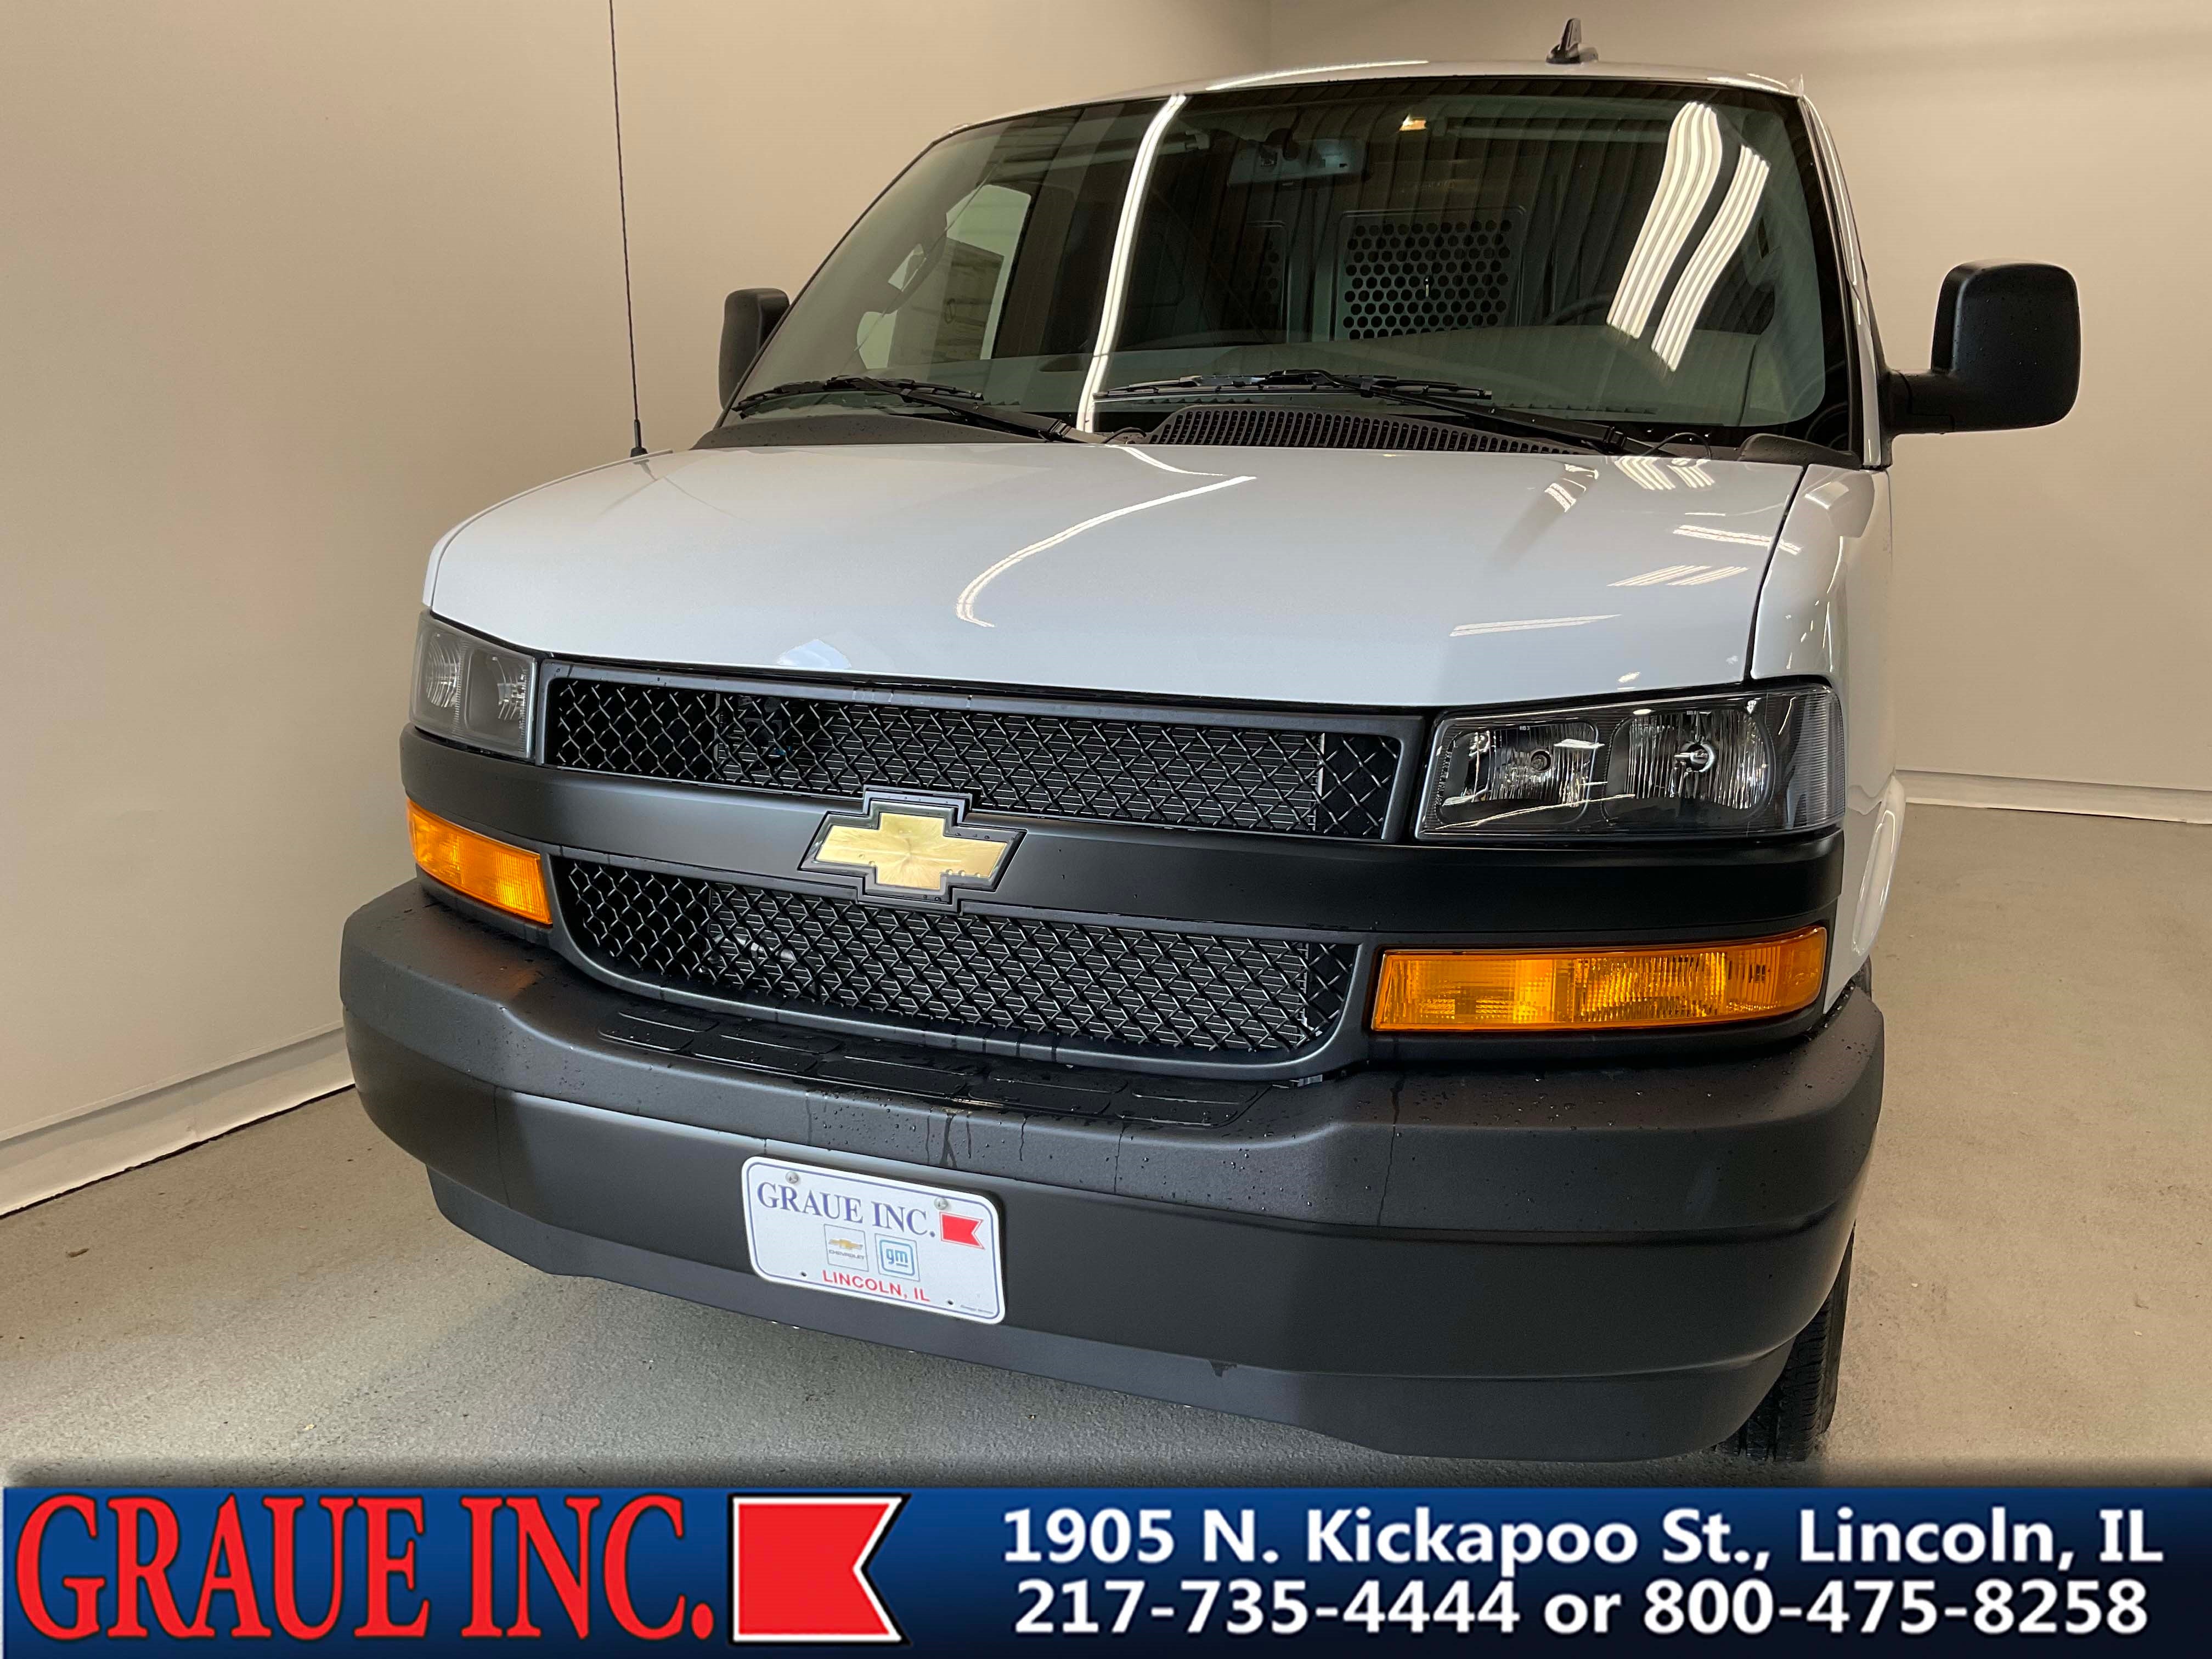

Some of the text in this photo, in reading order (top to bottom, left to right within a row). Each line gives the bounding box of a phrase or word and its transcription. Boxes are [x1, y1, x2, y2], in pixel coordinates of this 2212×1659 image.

[757, 1181, 936, 1238] GRAUE INC.
[828, 1249, 865, 1260] CHEVROLET
[885, 1248, 909, 1265] gm
[822, 1269, 931, 1302] LINCOLN, IL
